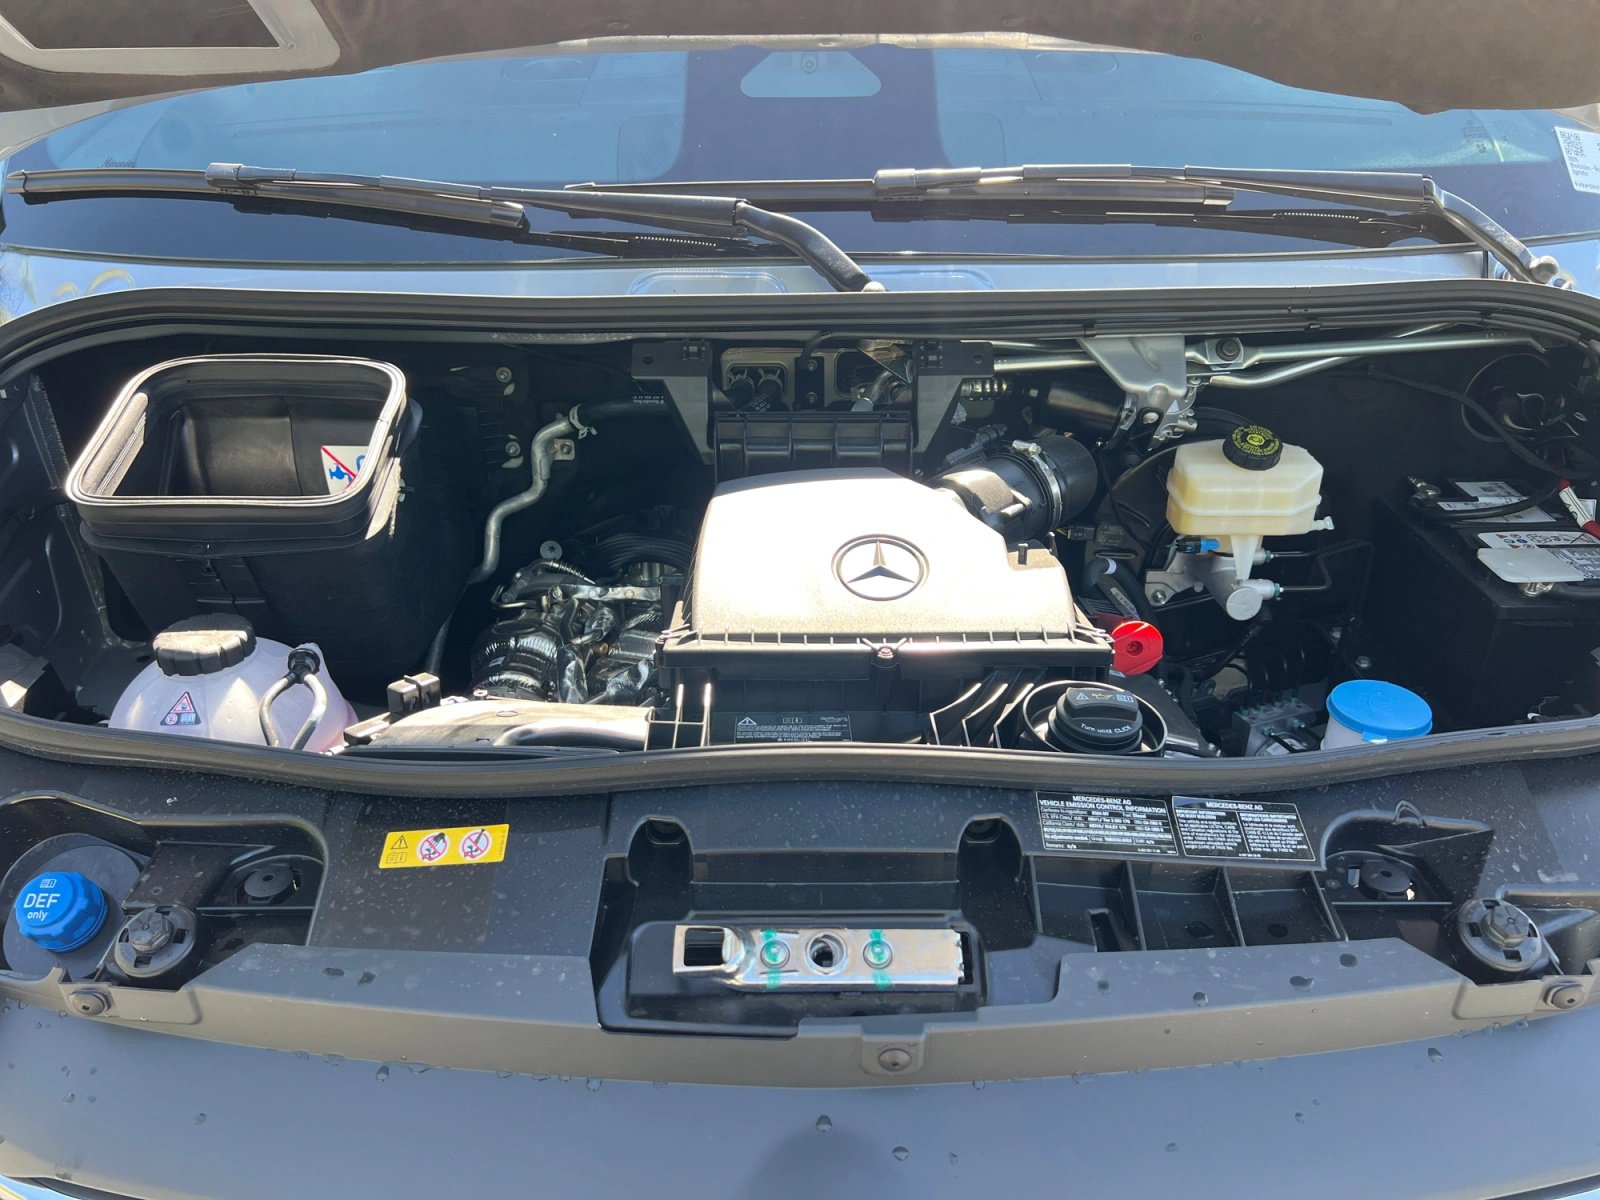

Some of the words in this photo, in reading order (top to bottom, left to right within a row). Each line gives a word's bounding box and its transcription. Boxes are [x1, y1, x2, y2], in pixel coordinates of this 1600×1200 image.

[1080, 722, 1096, 732] Turn
[1114, 725, 1132, 734] CLICK
[1072, 796, 1122, 805] MERCEDES-BENZ
[1205, 802, 1253, 810] MERCEDES-BENZ
[24, 893, 60, 908] DEF
[27, 910, 48, 921] only
